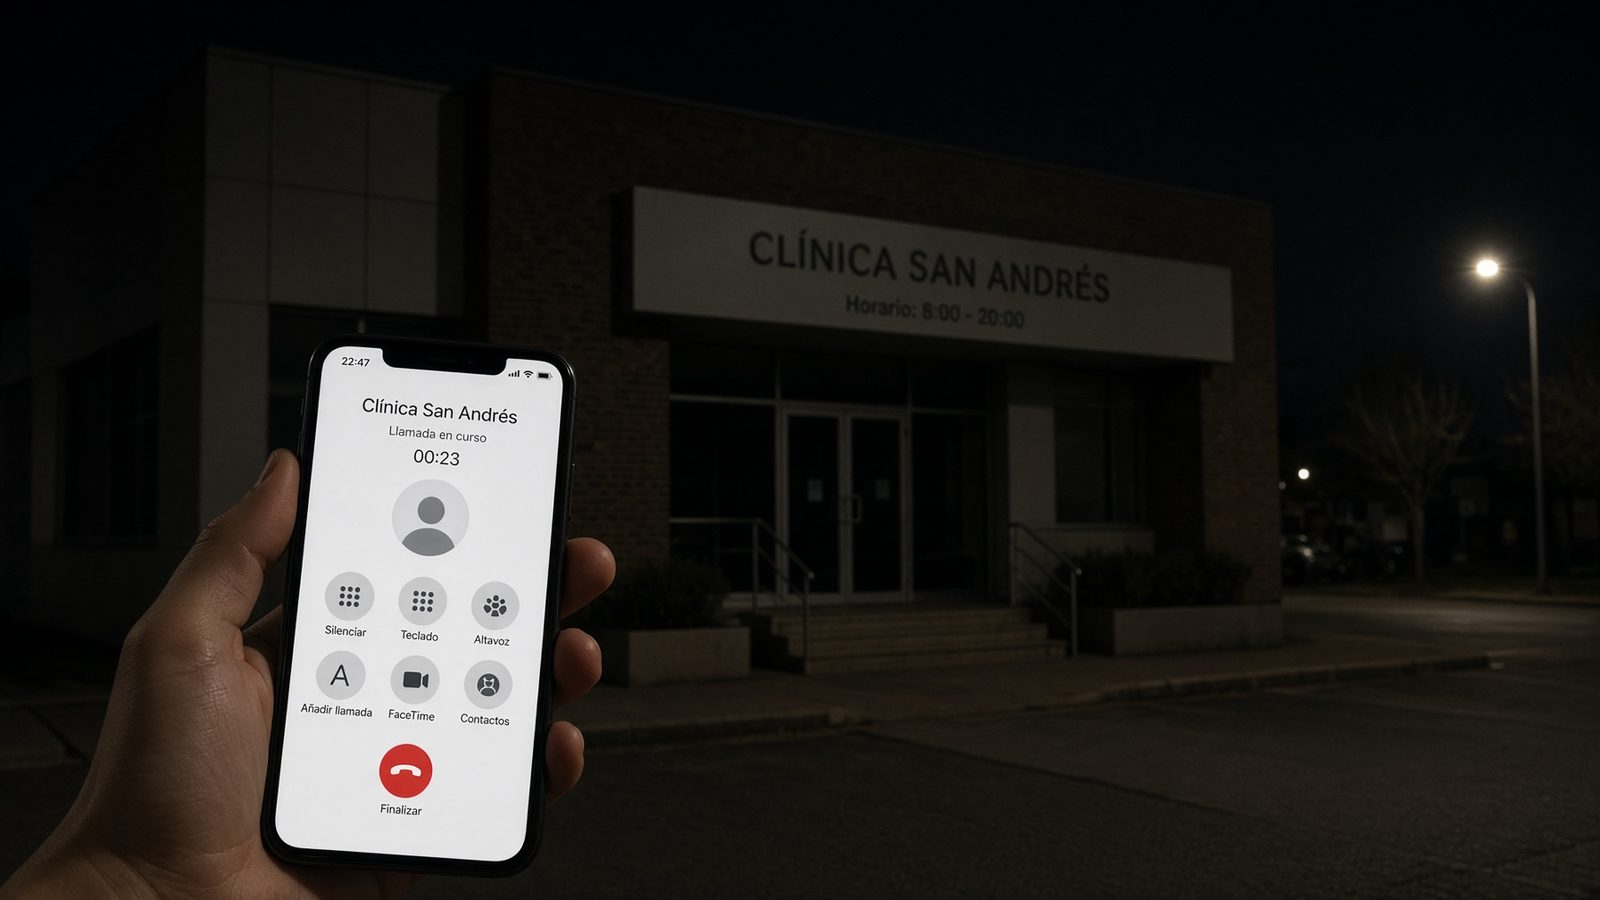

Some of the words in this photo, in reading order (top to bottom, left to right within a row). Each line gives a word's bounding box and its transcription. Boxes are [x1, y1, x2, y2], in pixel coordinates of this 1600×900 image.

[750, 229, 896, 280] CLÍNICA
[910, 250, 975, 288] SAN
[987, 263, 1110, 303] ANDRÉS
[846, 294, 917, 318] Horario:
[922, 302, 961, 323] 8:00
[977, 307, 1025, 328] 20:00
[341, 356, 371, 367] 22:47
[362, 398, 418, 417] Clínica
[423, 402, 454, 420] San
[458, 406, 518, 424] Andrés
[388, 426, 436, 439] Llamada
[439, 431, 453, 440] en
[455, 432, 487, 443] curso
[413, 449, 460, 466] 00:23
[325, 625, 367, 637] Silenciar
[400, 630, 439, 642] Teclado
[474, 635, 510, 647] Altavoz
[300, 703, 333, 715] Añadir
[334, 706, 373, 717] llamada
[388, 709, 435, 722] FaceTime
[460, 713, 510, 726] Contactos
[380, 803, 422, 816] Finalizar
